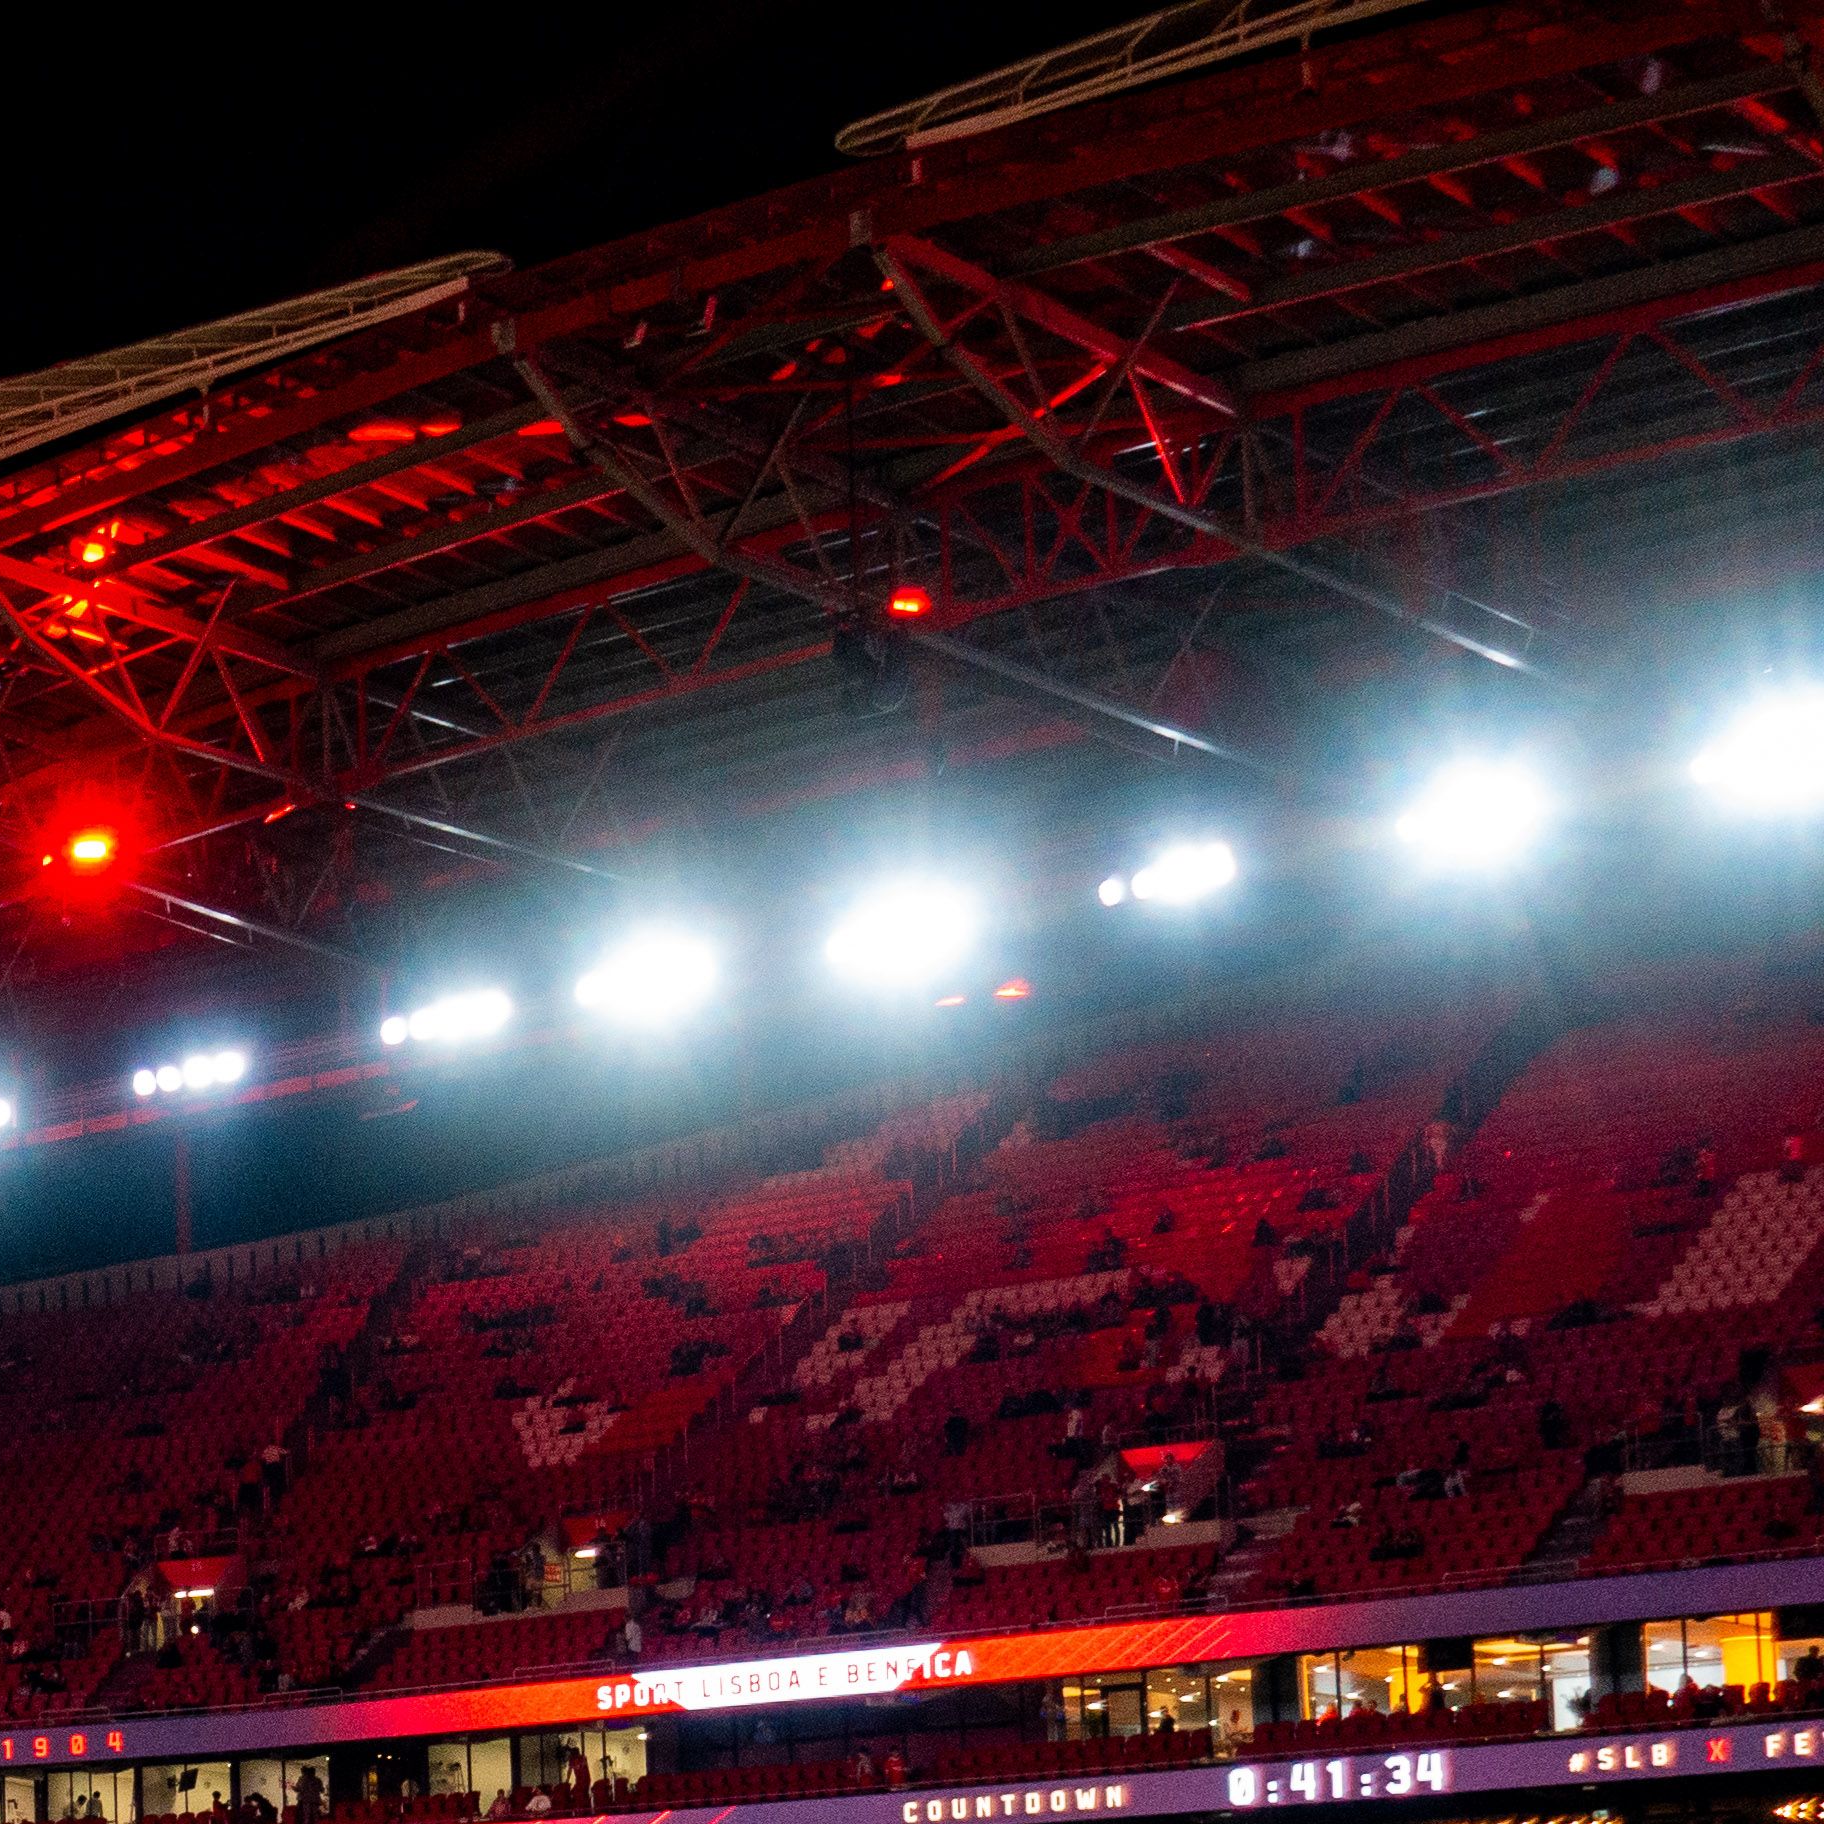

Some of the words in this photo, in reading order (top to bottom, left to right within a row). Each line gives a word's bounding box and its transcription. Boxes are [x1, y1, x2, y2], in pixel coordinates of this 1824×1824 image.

[702, 1670, 801, 1698] LISBOA
[819, 1667, 828, 1686] E
[848, 1651, 973, 1683] BENFICA
[1, 1731, 124, 1760] 1904
[1569, 1741, 1674, 1773] #SLB
[1764, 1729, 1824, 1759] FE
[902, 1785, 1128, 1824] COUNTDOWN
[1227, 1751, 1449, 1807] 0:41:34
